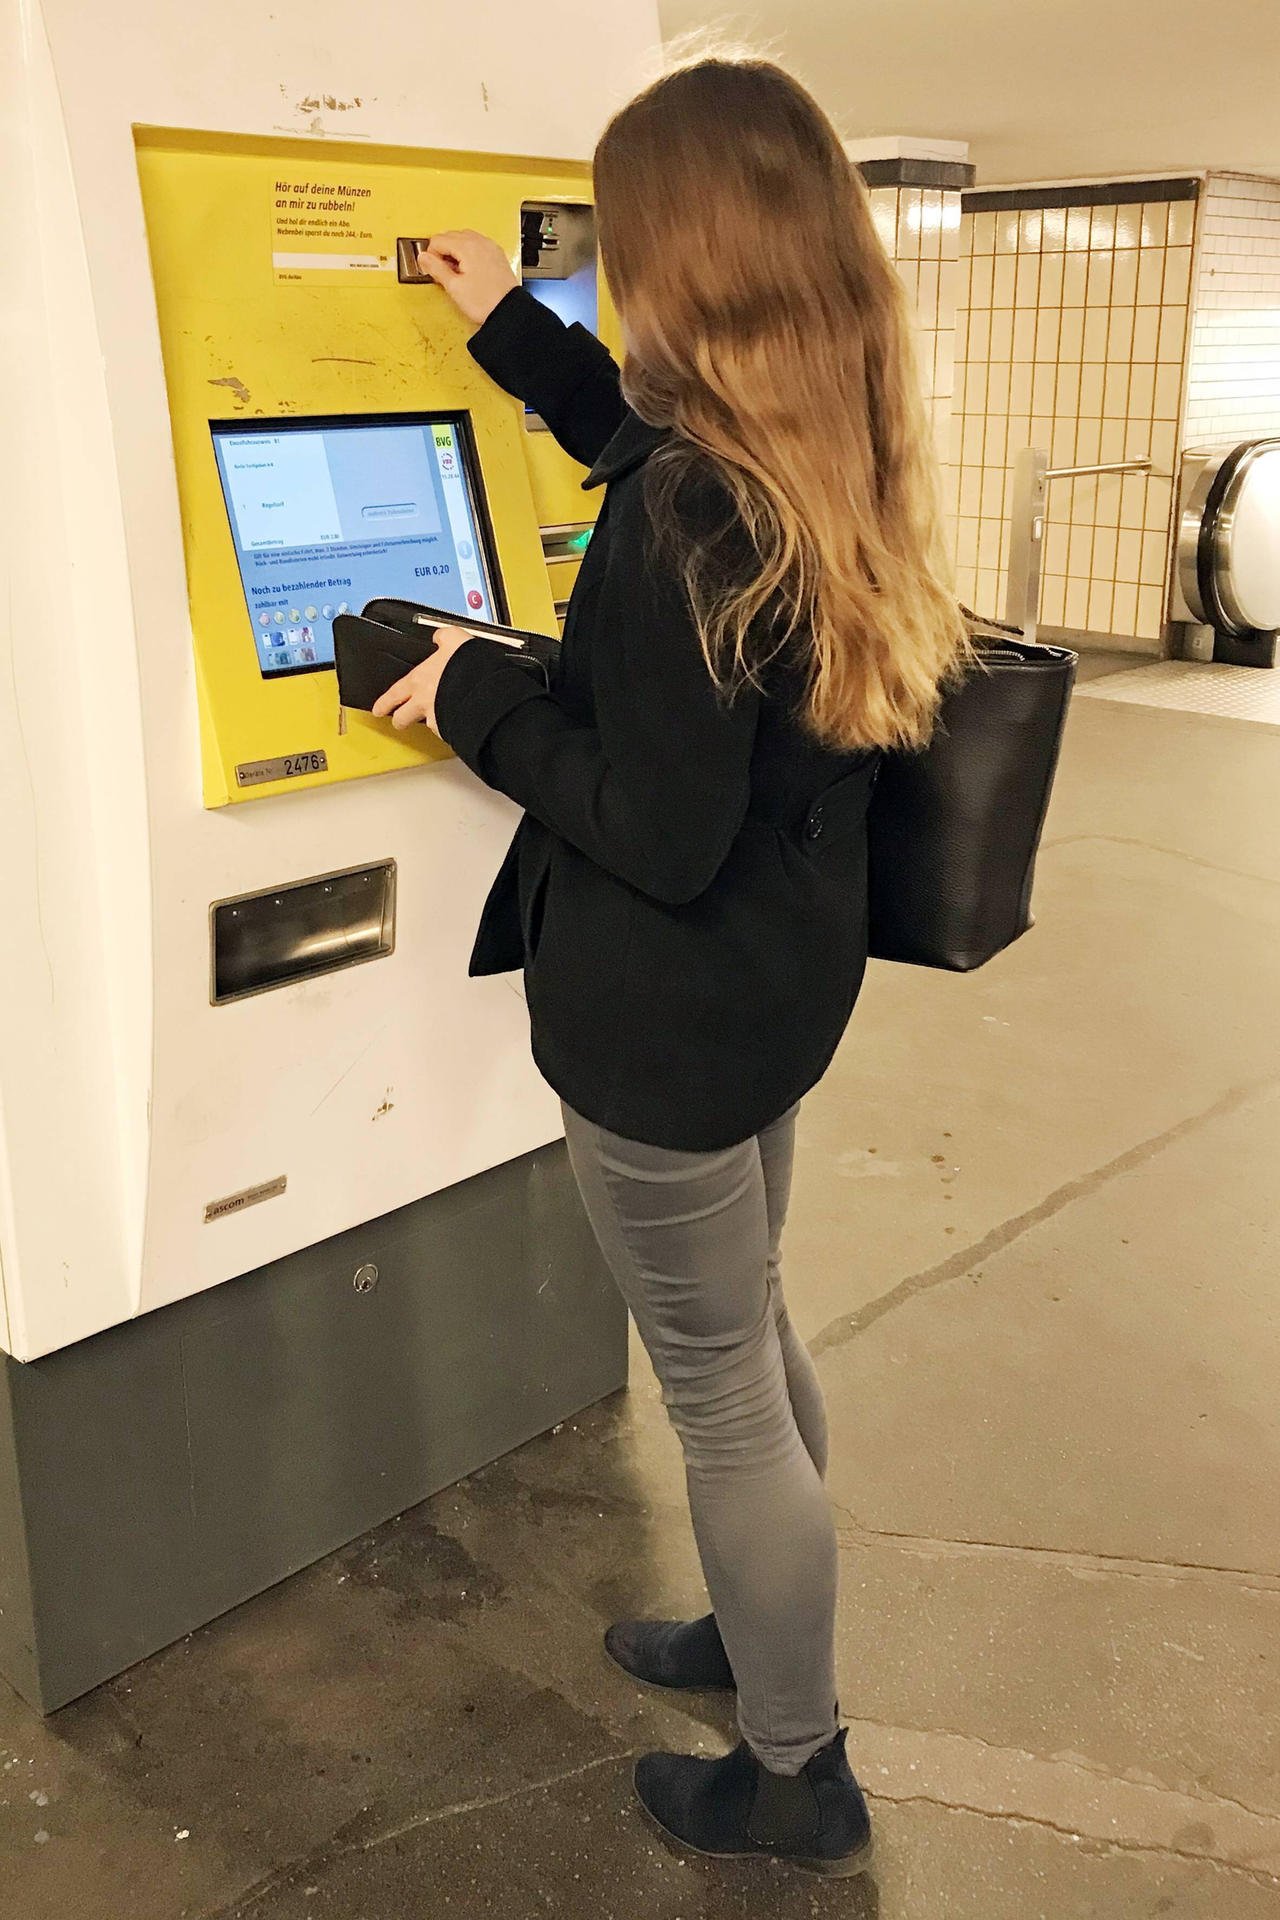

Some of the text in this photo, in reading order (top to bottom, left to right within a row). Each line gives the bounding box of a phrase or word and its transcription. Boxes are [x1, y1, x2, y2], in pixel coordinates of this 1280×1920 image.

[275, 181, 371, 197] Hör auf deine Münzen
[275, 199, 287, 208] an
[289, 199, 304, 209] mir
[319, 200, 356, 212] rubbeln!
[436, 437, 452, 446] BVG
[251, 586, 271, 595] Noch
[282, 580, 326, 592] bezahlender
[327, 578, 352, 588] Betrag
[414, 567, 432, 577] EUR
[432, 564, 450, 575] 0,20
[255, 600, 276, 609] zahlbar
[284, 754, 320, 775] 2476
[213, 1198, 245, 1215] ascom
